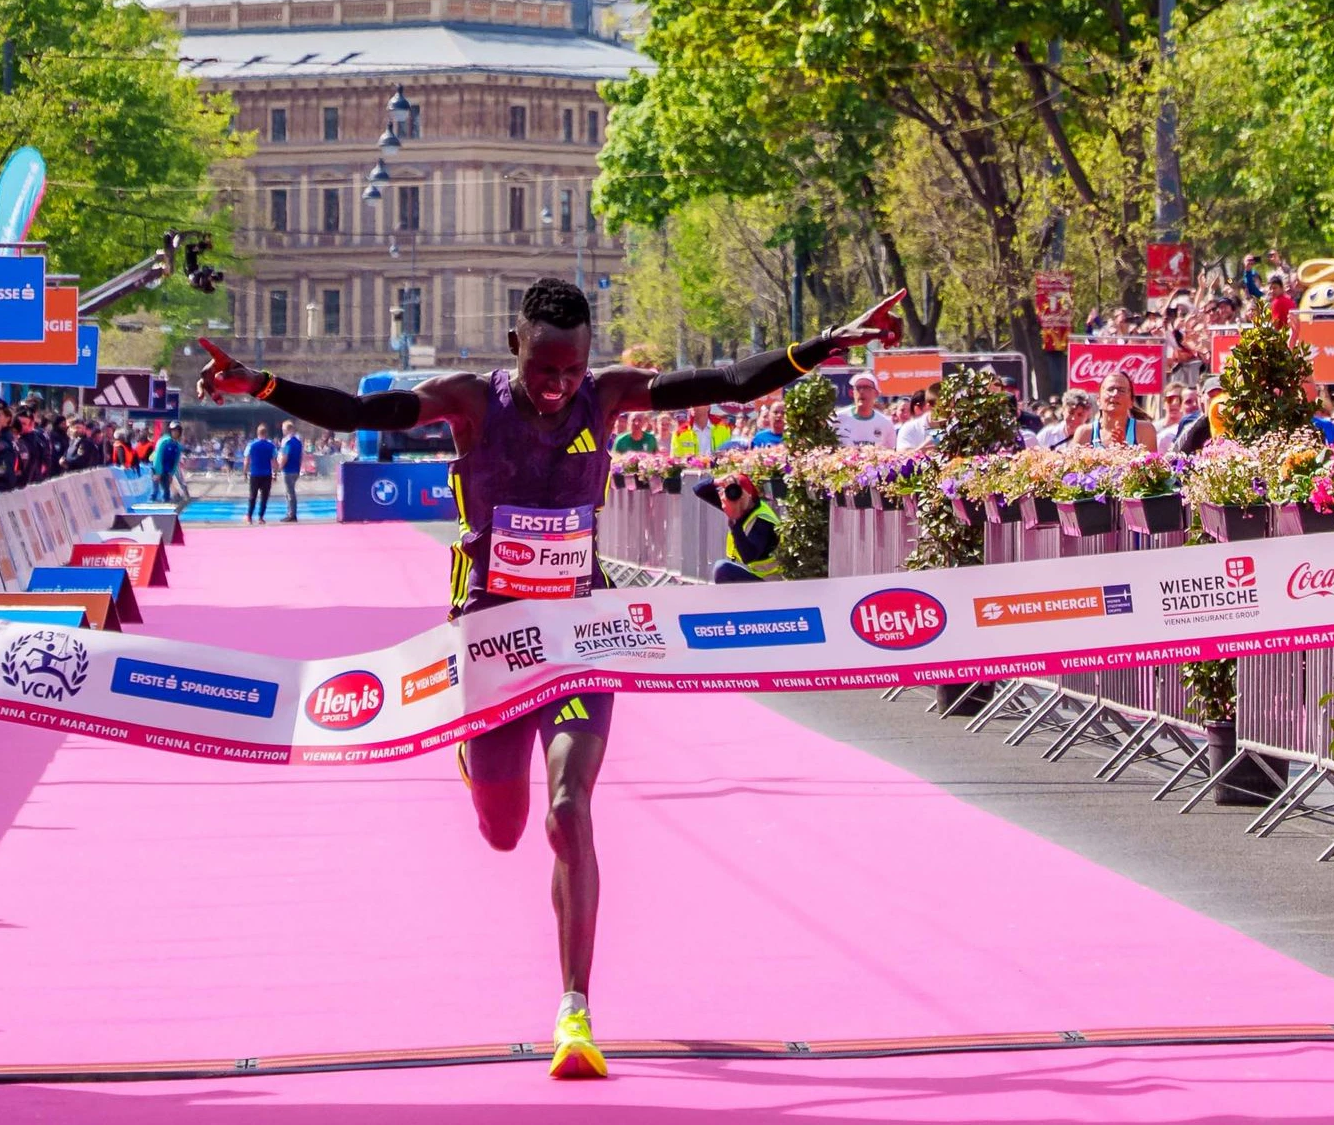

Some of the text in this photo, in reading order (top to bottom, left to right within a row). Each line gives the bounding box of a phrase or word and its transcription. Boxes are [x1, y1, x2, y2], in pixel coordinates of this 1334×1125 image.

[510, 513, 564, 532] ERSTE
[82, 556, 123, 567] WIENER
[497, 544, 532, 561] Hervis
[539, 548, 588, 568] Fanny
[510, 582, 534, 592] WIEN
[535, 583, 571, 593] ENERGIE
[1159, 575, 1226, 595] WIENER
[1007, 601, 1043, 615] WIEN
[1045, 596, 1099, 612] ENERGIE
[1161, 588, 1259, 612] STÄDTISCHE
[859, 602, 940, 637] Hervis
[1163, 611, 1261, 625] VIENNA INSURANCE GROUP
[573, 618, 631, 639] WIENER
[693, 621, 798, 637] ERSTE SPARKASSE
[874, 631, 905, 642] SPORTS
[467, 625, 543, 662] POWER
[574, 632, 666, 654] STÄDTISCHE
[1217, 641, 1261, 654] VIENNA
[1265, 637, 1291, 651] CITY
[504, 645, 547, 672] ADE
[1060, 645, 1201, 668] VIENNA CITY MARATHON
[772, 672, 900, 688] VIENNA CITY MARATHON
[913, 660, 1047, 681] VIENNA CITY MARATHON
[21, 680, 64, 702] VCM
[129, 672, 247, 702] ERSTE SPARKASSE
[635, 678, 760, 690] VIENNA CITY MARATHON
[313, 685, 380, 718] Hervis
[499, 677, 623, 722] VIENNA CITY MARATHON
[29, 711, 58, 725] CITY
[59, 718, 129, 739] MARATHON
[321, 713, 349, 723] SPORTS
[145, 733, 289, 761] VIENNA CITY MARATHON
[420, 735, 441, 749] VIENNA
[440, 730, 454, 743] CITY
[302, 743, 414, 761] VIENNA CITY MARATHON
